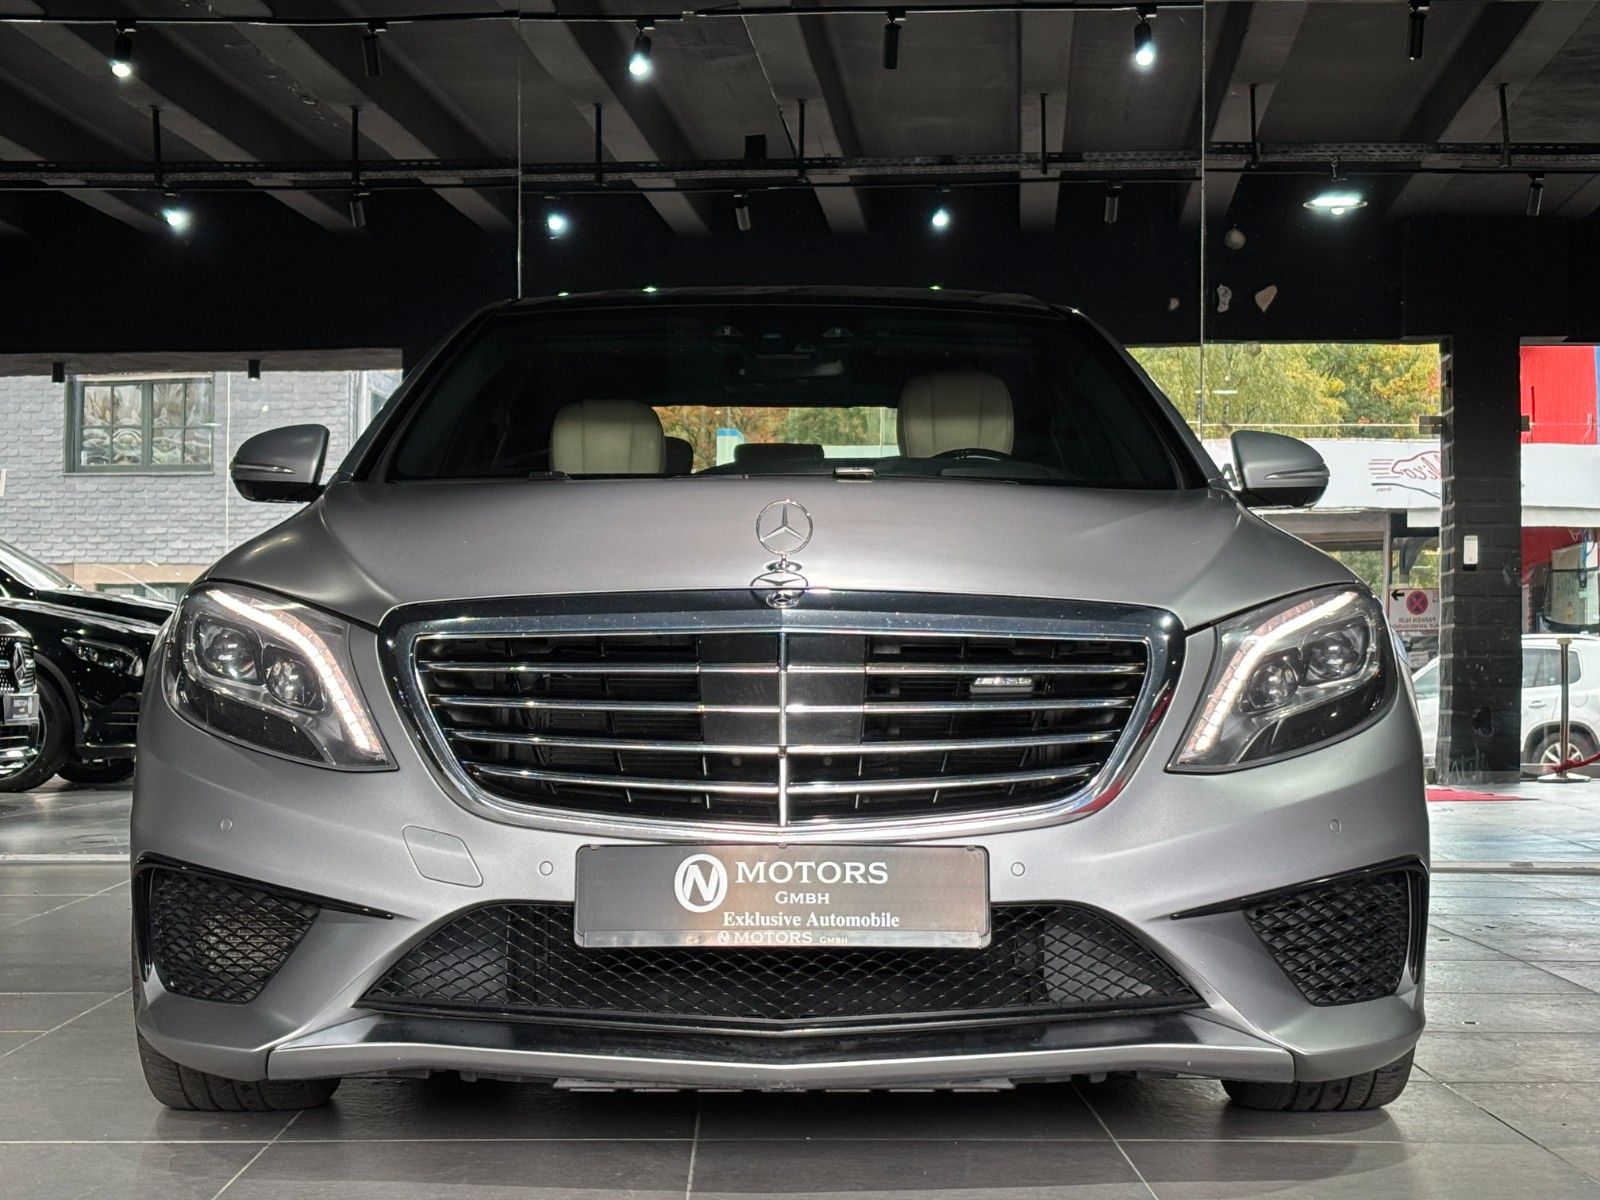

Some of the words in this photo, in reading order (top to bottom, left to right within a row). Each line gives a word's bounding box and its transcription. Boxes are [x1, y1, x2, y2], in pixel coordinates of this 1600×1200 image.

[734, 861, 889, 884] MOTORS
[775, 891, 830, 905] GMBH
[722, 911, 802, 927] Exklusive
[806, 912, 900, 928] Automobile
[734, 932, 813, 944] MOTORS
